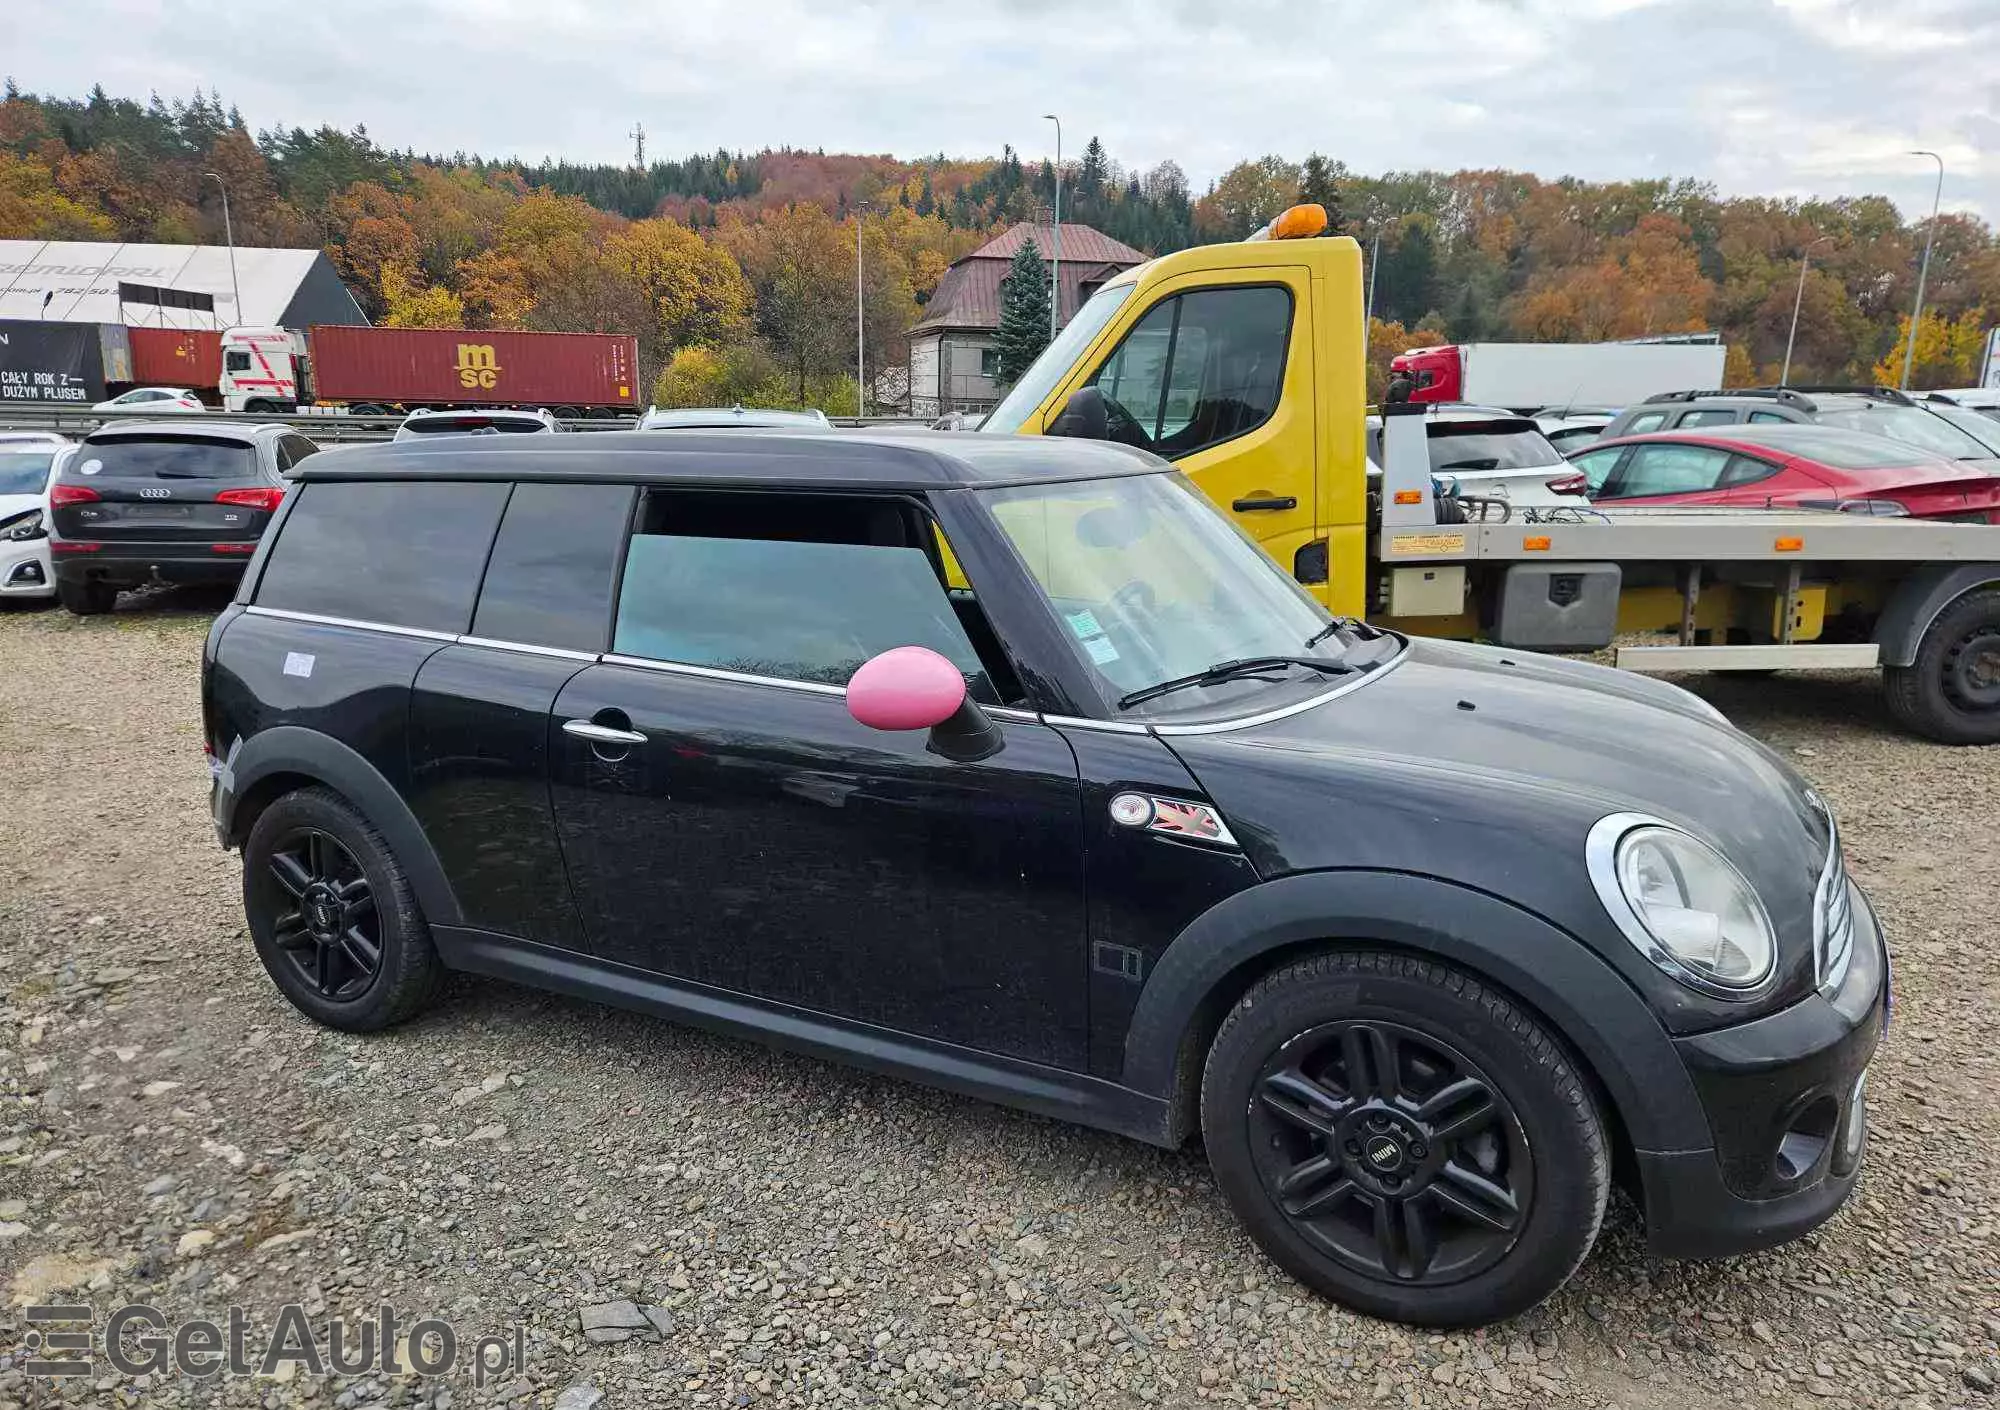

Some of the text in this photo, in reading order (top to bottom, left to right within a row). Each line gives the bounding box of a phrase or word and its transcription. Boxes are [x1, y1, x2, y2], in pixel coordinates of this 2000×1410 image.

[1, 371, 28, 385] CAŁY
[34, 373, 55, 385] ROK
[2, 383, 86, 400] DUŻYM PLUSEM
[1371, 1143, 1397, 1163] MINI
